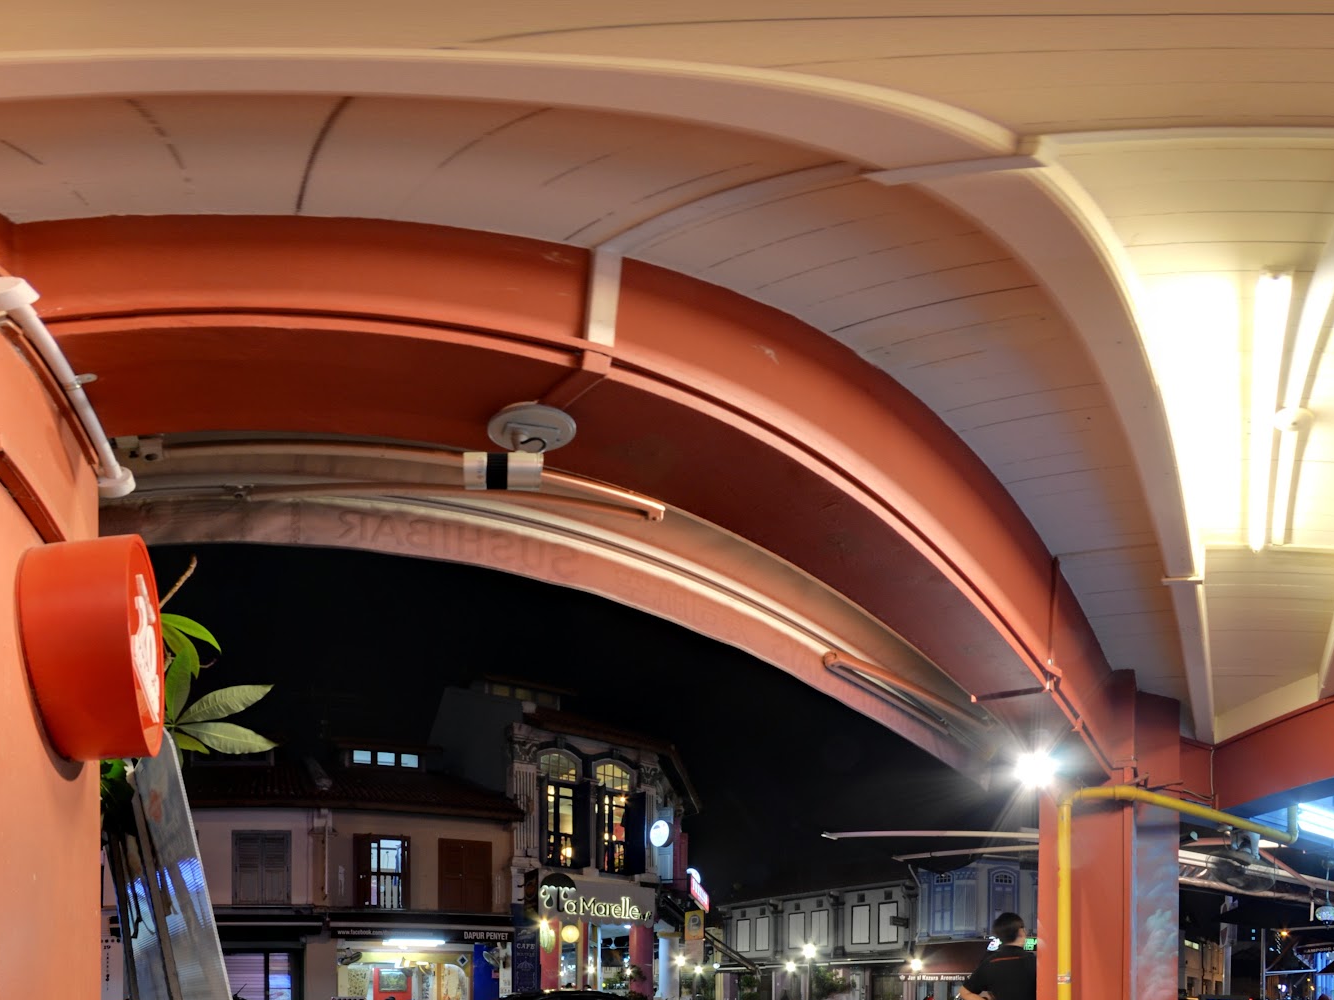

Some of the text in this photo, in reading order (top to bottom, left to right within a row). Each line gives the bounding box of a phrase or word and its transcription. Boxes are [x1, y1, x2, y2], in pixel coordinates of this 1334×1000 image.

[579, 896, 641, 920] Marelle
[463, 931, 508, 941] DAPUR PENYET
